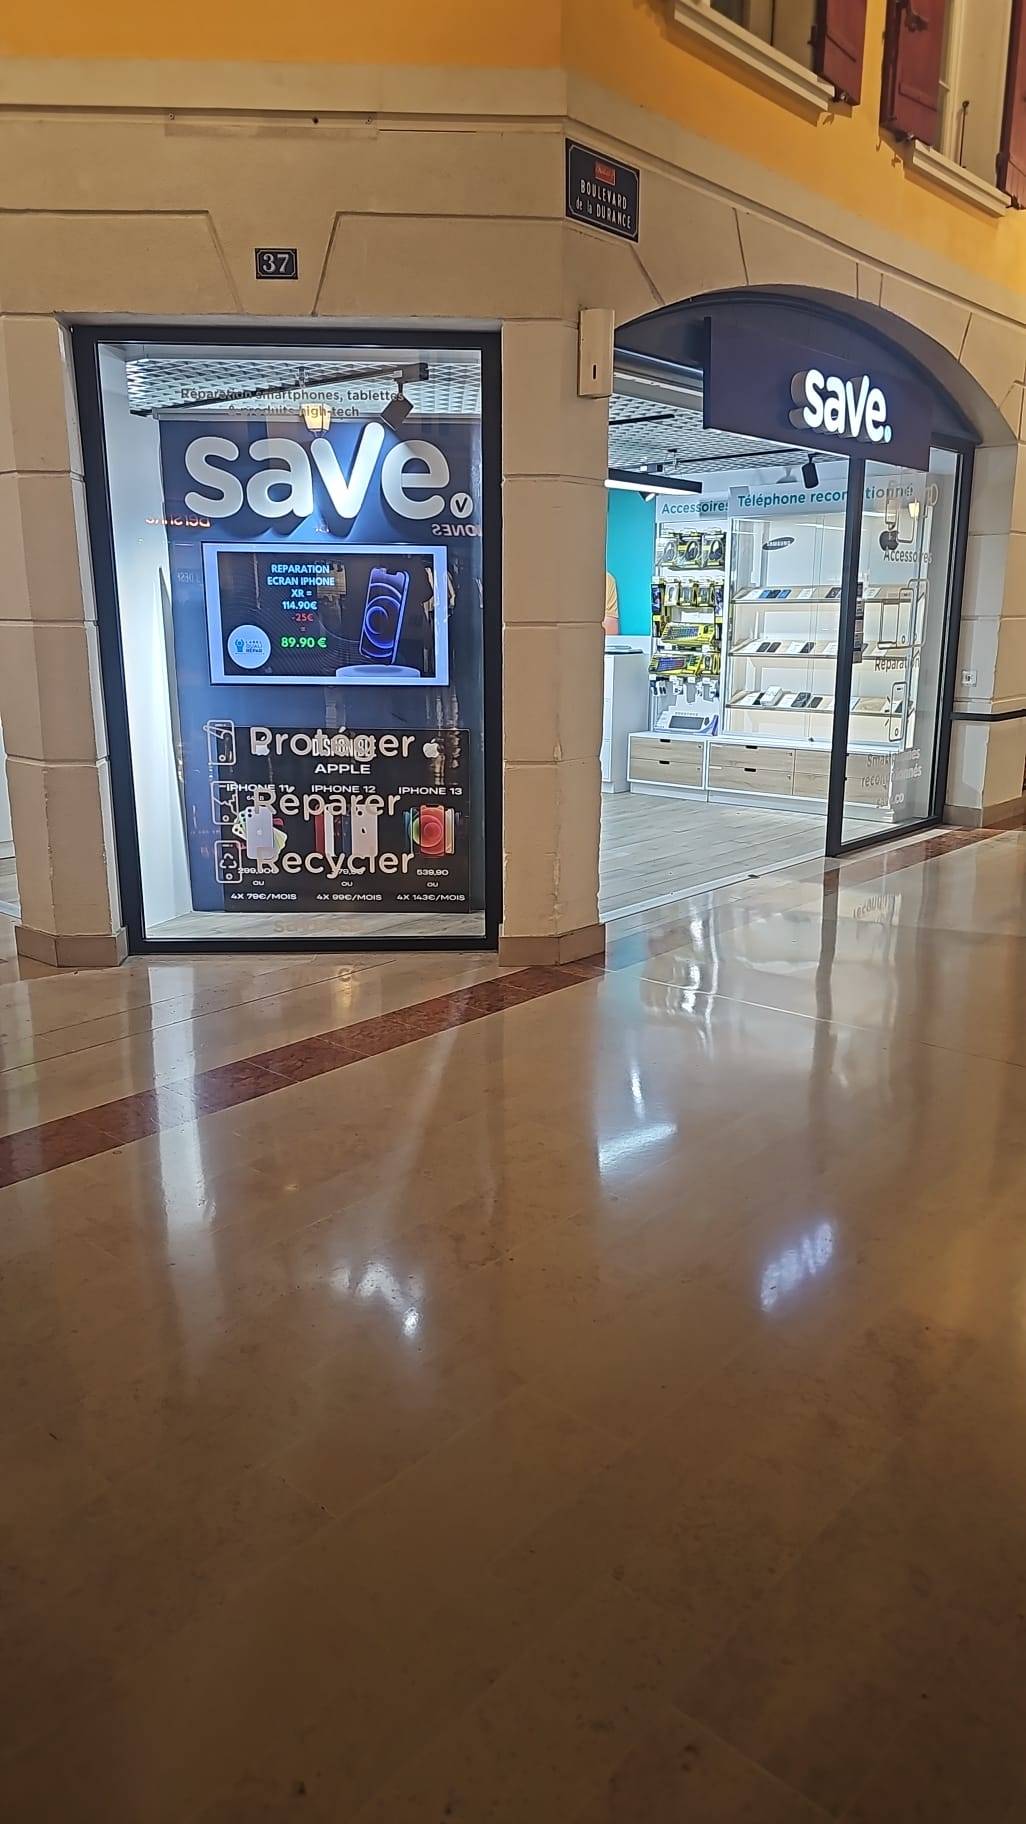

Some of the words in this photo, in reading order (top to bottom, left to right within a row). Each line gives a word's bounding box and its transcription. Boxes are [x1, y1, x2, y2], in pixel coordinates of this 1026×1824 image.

[580, 179, 627, 210] BOULEVARD
[575, 196, 583, 211] de
[587, 200, 593, 215] la
[596, 203, 631, 229] DURANCE
[262, 253, 289, 273] 37
[347, 389, 404, 401] tablettes
[803, 369, 892, 443] save.
[738, 493, 806, 508] Téléphone
[271, 564, 330, 574] REPARATION
[267, 576, 298, 586] ECRAN
[300, 576, 335, 586] IPHONE
[290, 588, 305, 598] XR
[281, 600, 318, 611] 114.90€
[291, 613, 314, 622] -25€
[281, 637, 315, 648] 89.90
[317, 637, 327, 648] €
[250, 726, 416, 762] Protéger
[314, 763, 371, 775] APPLE
[226, 784, 275, 792] IPHONE
[311, 784, 352, 793] IPHONE
[354, 784, 376, 793] 12
[398, 786, 447, 795] IPHONE
[449, 787, 463, 796] 13
[253, 786, 401, 821] Réparer
[332, 893, 382, 901] 99€/MOIS
[412, 894, 466, 902] 143€/MOIS
